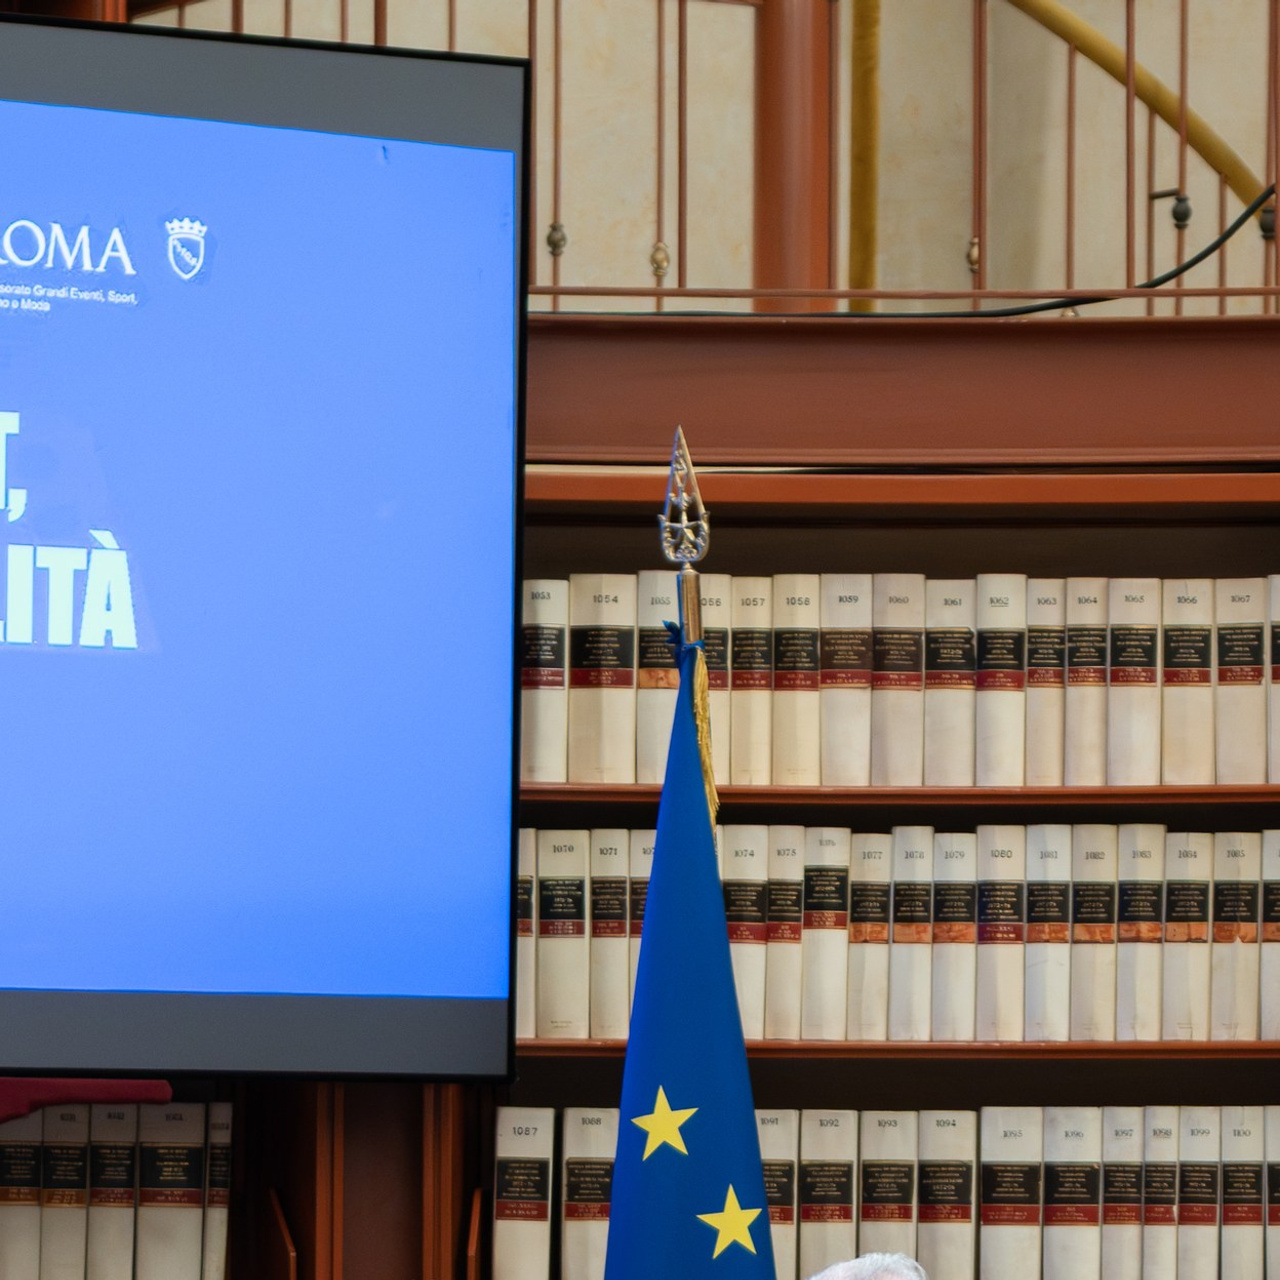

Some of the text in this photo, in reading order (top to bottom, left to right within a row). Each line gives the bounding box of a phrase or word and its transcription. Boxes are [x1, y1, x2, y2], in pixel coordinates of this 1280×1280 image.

[0, 219, 137, 276] OMA
[33, 285, 68, 298] Grandi
[107, 290, 138, 305] Sport,
[20, 299, 50, 311] Moda
[0, 529, 138, 650] ITÀ
[593, 595, 618, 603] 1054
[700, 598, 721, 606] 056
[741, 598, 765, 606] 1057
[786, 597, 810, 605] 1058
[889, 596, 909, 604] 1060
[990, 597, 1008, 607] 1062
[1125, 595, 1144, 603] 1065
[1177, 596, 1197, 604] 1066
[863, 851, 883, 859] 1077
[991, 850, 1012, 858] 1080
[819, 1119, 839, 1127] 1092
[936, 1119, 956, 1127] 1094
[513, 1127, 538, 1135] 1087
